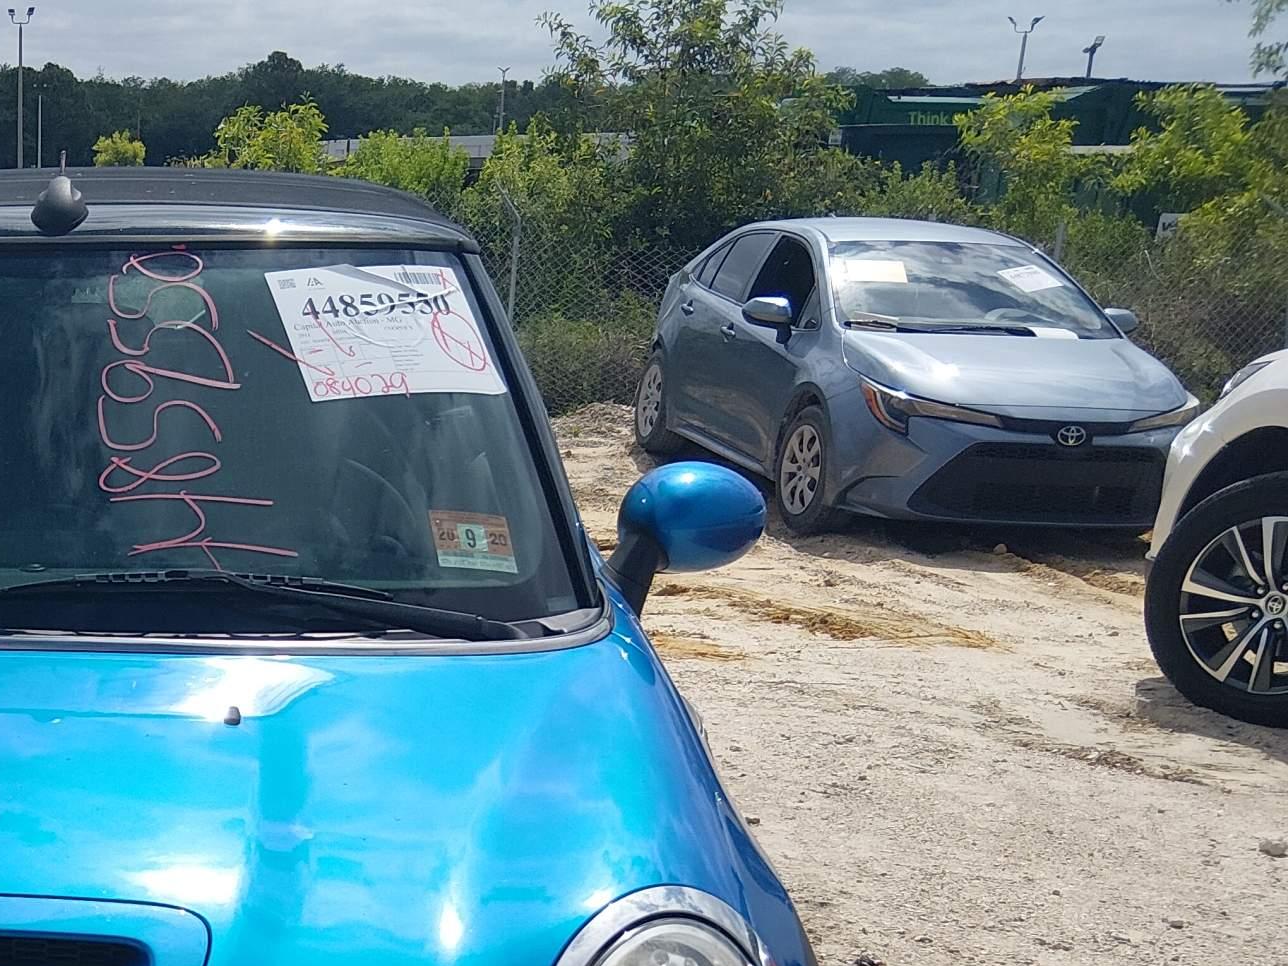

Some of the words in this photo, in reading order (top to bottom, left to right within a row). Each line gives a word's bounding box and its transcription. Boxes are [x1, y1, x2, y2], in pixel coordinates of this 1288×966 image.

[908, 111, 949, 126] Think
[302, 293, 450, 320] 44859550
[465, 528, 477, 548] 9
